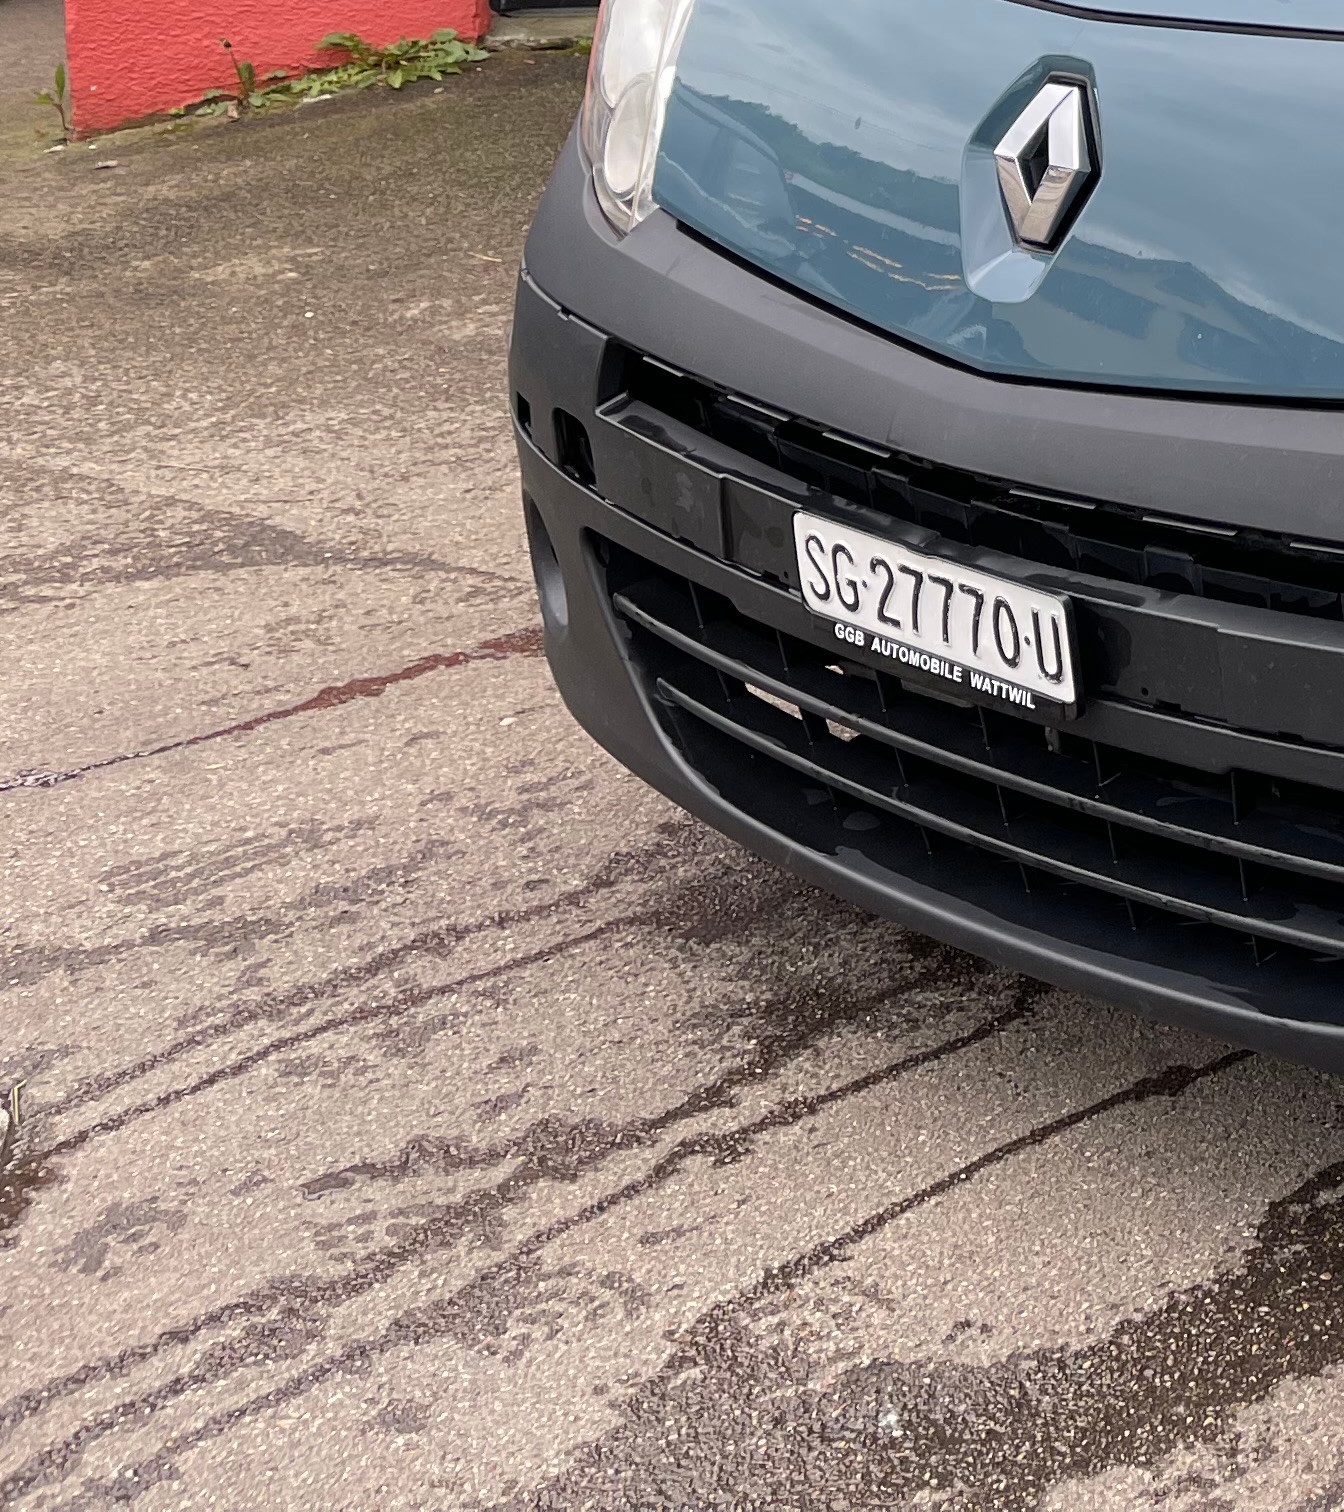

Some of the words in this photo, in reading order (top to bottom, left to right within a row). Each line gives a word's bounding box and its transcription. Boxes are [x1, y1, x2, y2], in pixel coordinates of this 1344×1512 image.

[833, 622, 866, 647] GGB
[870, 635, 964, 684] AUTOMOBILE
[969, 671, 1037, 710] WATTWIL
